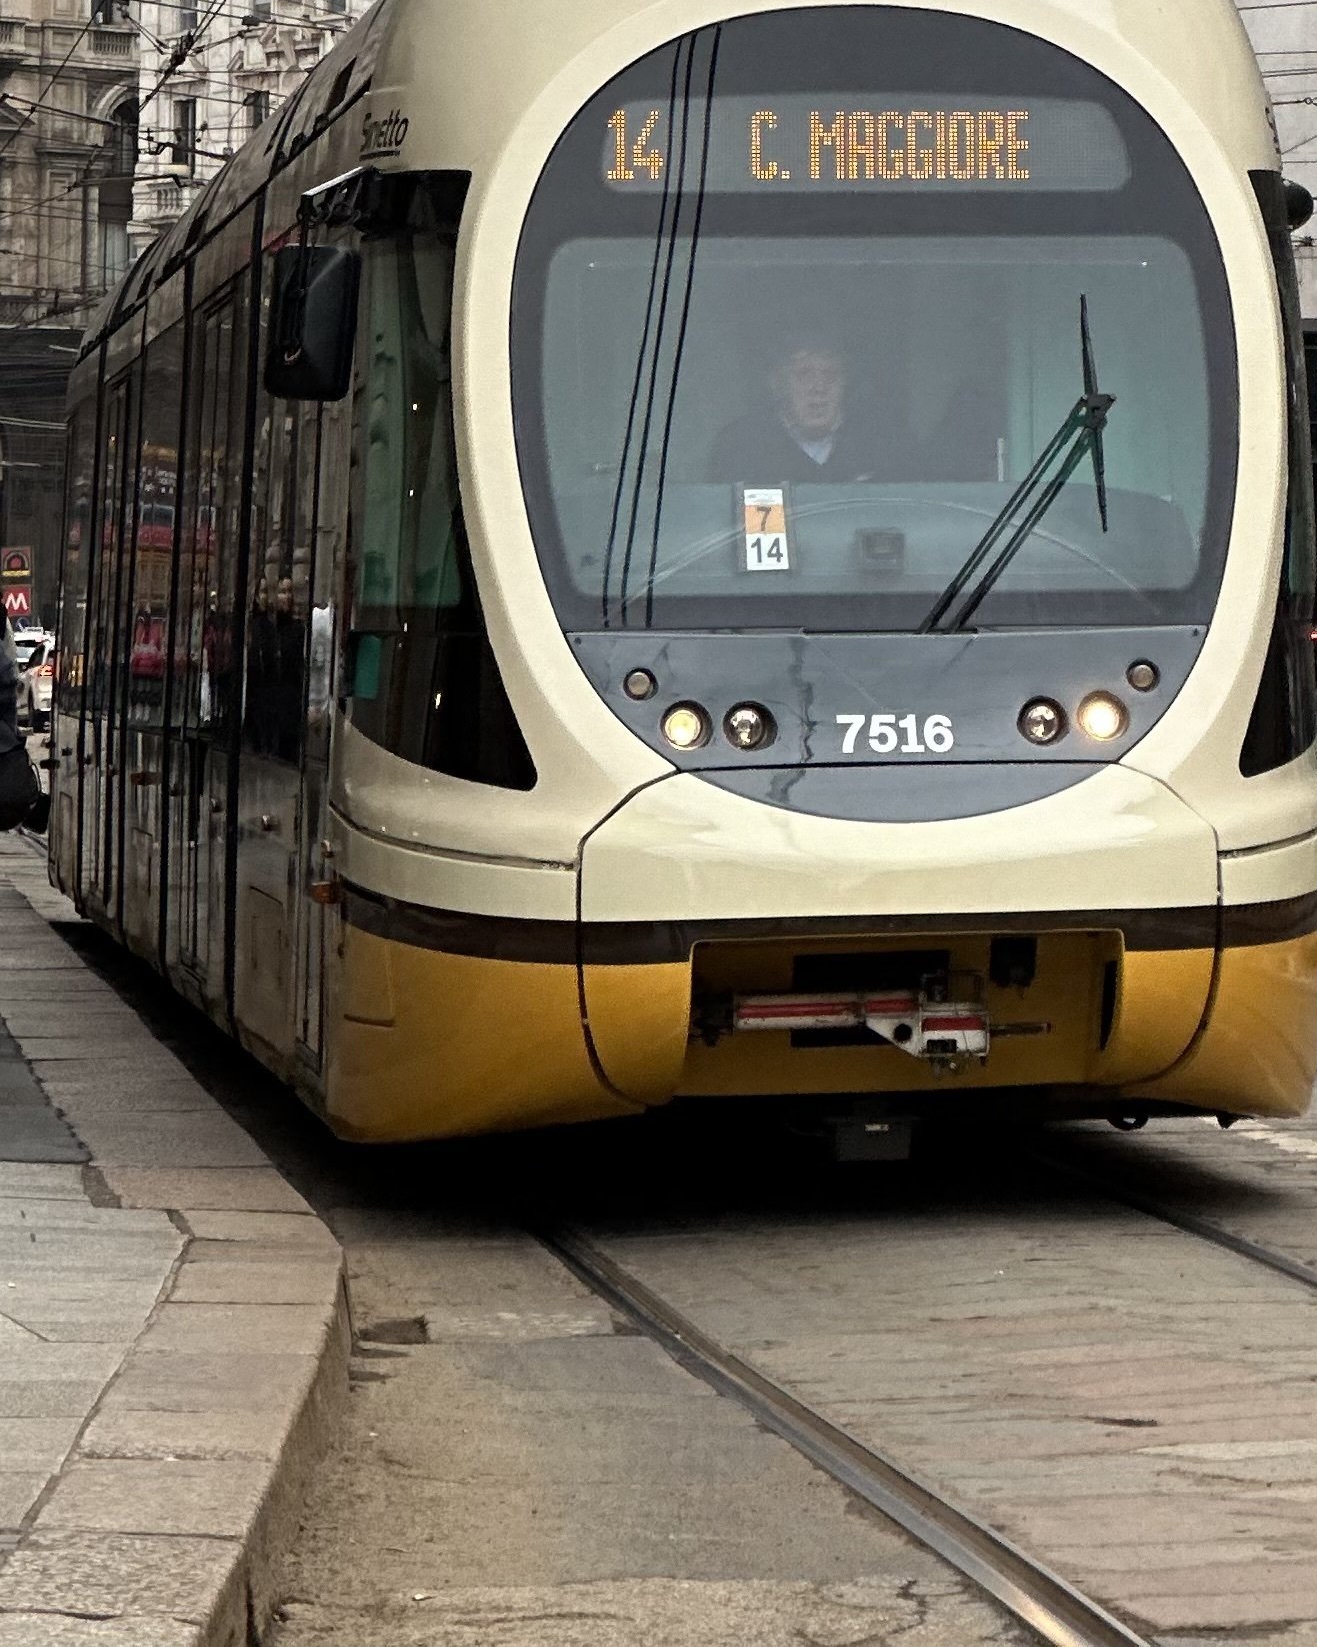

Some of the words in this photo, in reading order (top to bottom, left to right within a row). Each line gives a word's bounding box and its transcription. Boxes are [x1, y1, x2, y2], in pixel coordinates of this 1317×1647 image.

[607, 110, 664, 180] 14
[750, 111, 790, 180] C.
[810, 111, 1030, 180] MAGGIORE
[757, 506, 771, 531] 7
[751, 537, 783, 563] 14
[5, 593, 28, 610] M
[836, 714, 954, 753] 7516
